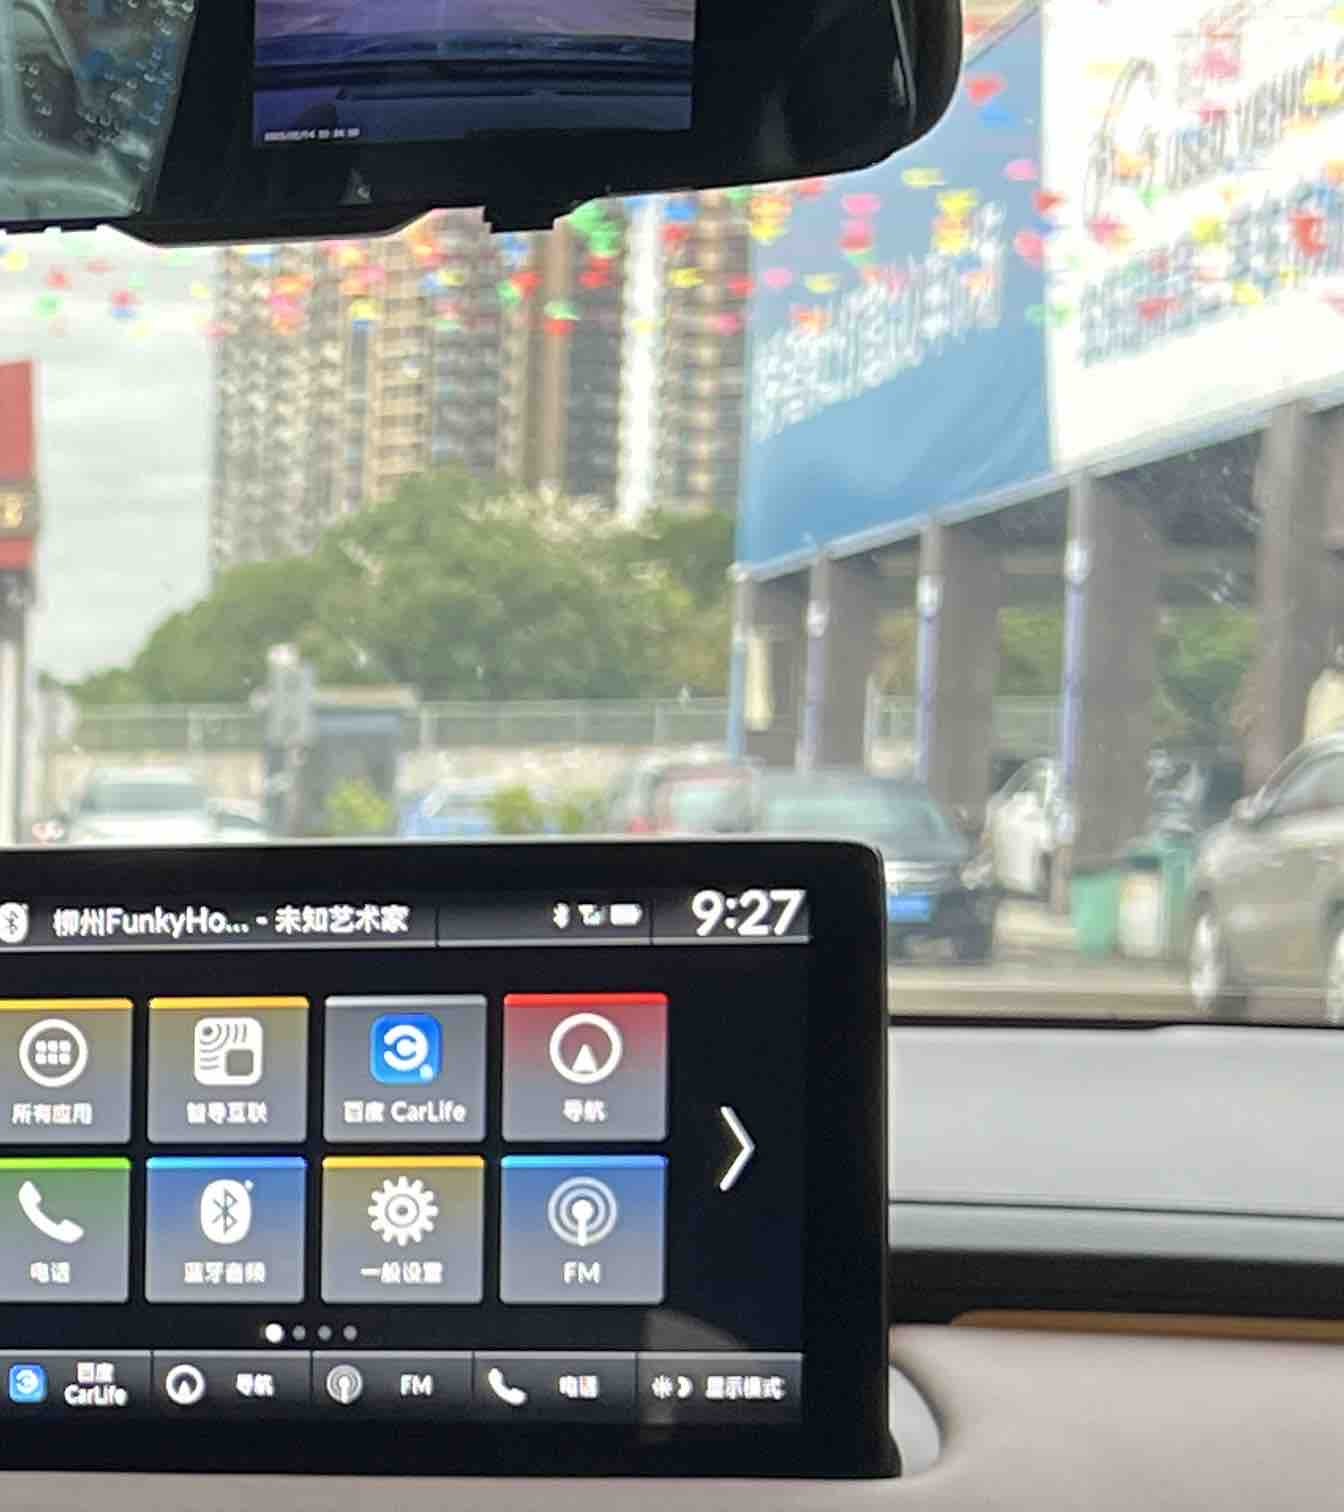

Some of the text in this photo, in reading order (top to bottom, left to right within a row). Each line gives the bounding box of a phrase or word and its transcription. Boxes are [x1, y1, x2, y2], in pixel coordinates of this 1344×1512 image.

[274, 905, 410, 934] 未知艺术家
[691, 888, 807, 937] 9:27
[11, 1102, 94, 1126] 所有应用
[343, 1100, 468, 1124] 百度 CarLife
[562, 1099, 608, 1123] 导航
[29, 1262, 72, 1285] 电话
[183, 1261, 267, 1284] 蓝牙音频
[359, 1261, 444, 1285] 一般设置
[562, 1262, 602, 1284] FM
[63, 1384, 127, 1408] CarLife
[399, 1373, 433, 1396] FM
[705, 1375, 786, 1400] 显示模式
